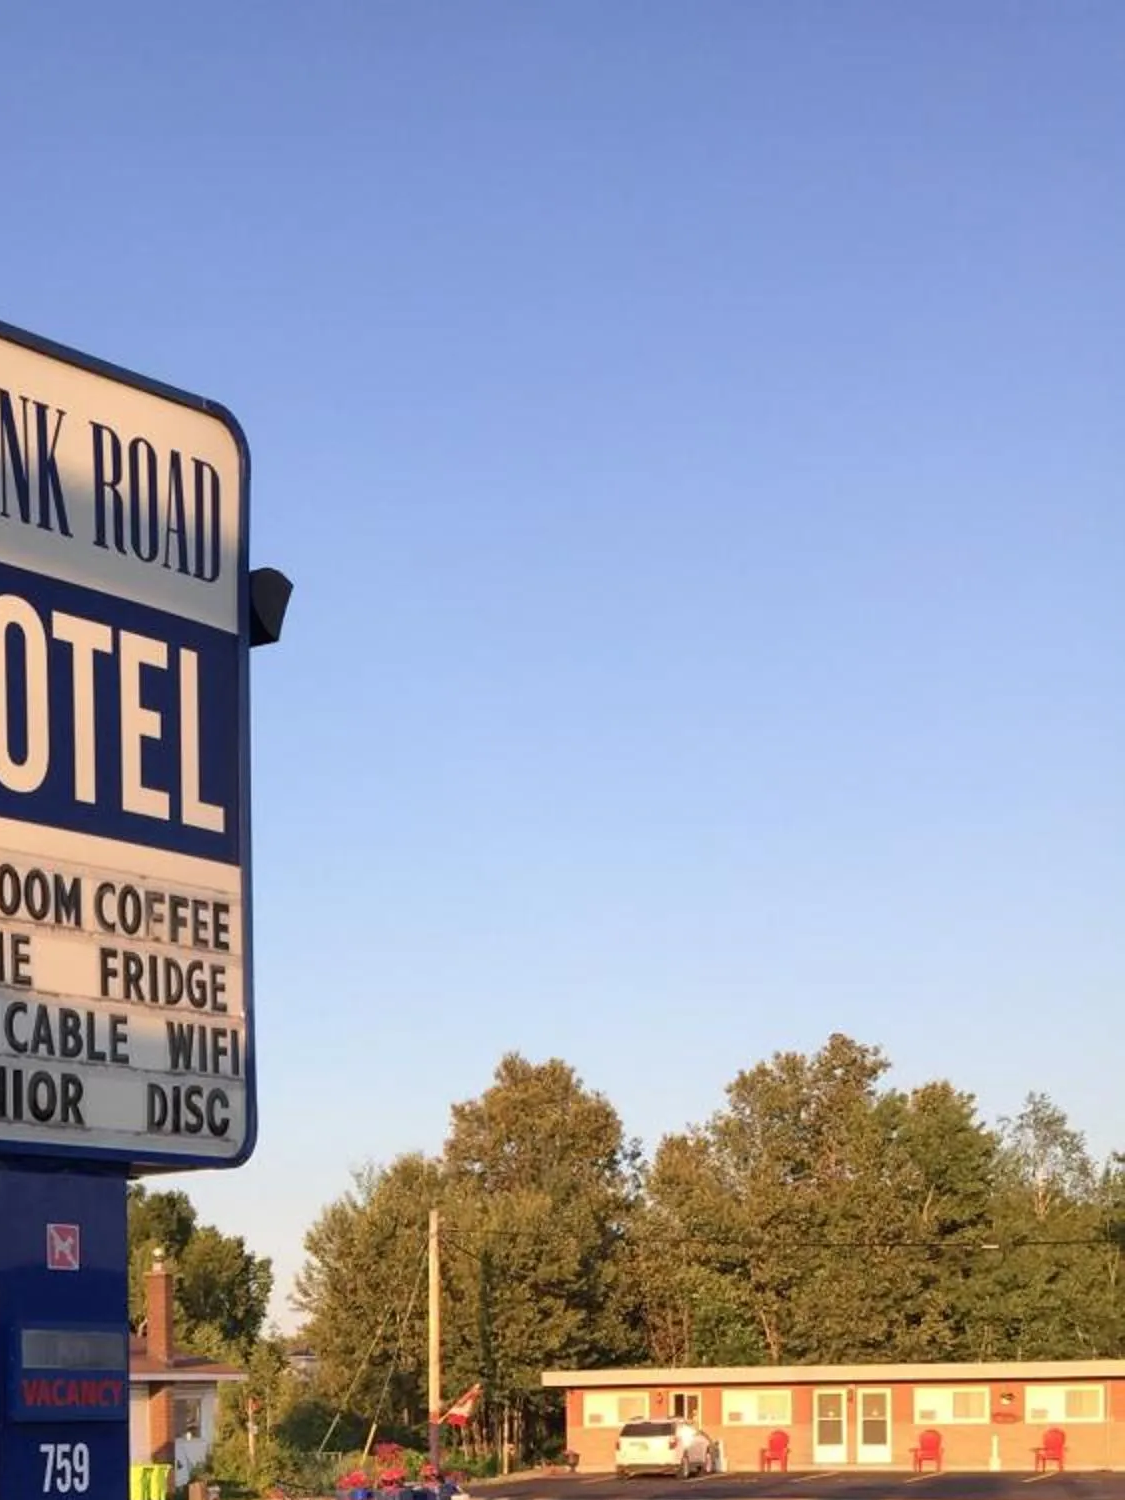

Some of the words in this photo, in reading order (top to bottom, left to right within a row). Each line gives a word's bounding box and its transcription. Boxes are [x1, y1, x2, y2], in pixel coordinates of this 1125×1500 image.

[90, 421, 222, 584] ROAD
[94, 882, 230, 951] COFFEE
[100, 947, 228, 1013] FRIDGE
[4, 1001, 130, 1065] CABLE
[166, 1021, 240, 1076] WIFI
[146, 1083, 231, 1137] DISC
[22, 1379, 123, 1407] VACANCY
[40, 1443, 90, 1493] 759
